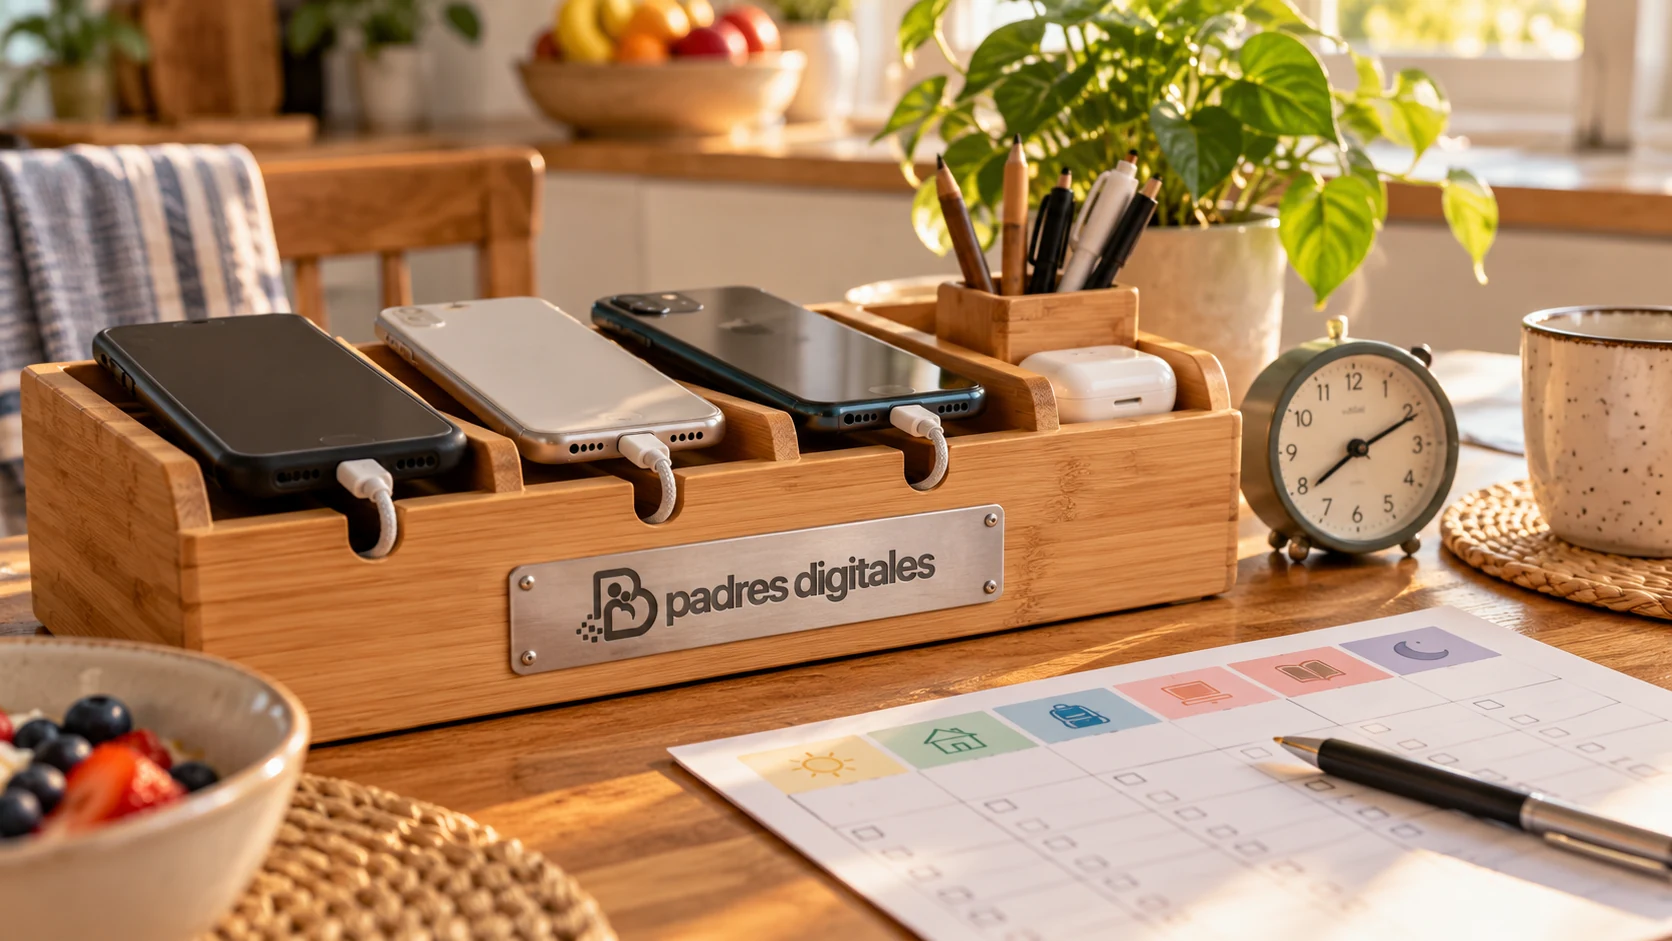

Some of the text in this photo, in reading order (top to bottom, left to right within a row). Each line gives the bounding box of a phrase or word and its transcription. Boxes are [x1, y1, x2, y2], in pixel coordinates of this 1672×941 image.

[1345, 373, 1363, 391] 12
[1382, 380, 1388, 398] 1
[1317, 384, 1329, 401] 11
[1294, 410, 1312, 427] 10
[1402, 403, 1413, 421] 2
[1286, 444, 1297, 461] 9
[1412, 436, 1423, 454] 3
[1297, 477, 1308, 495] 8
[1404, 470, 1415, 487] 4
[1322, 498, 1332, 516] 7
[1384, 495, 1394, 513] 5
[1352, 505, 1363, 523] 6
[666, 549, 936, 626] padres digitales
